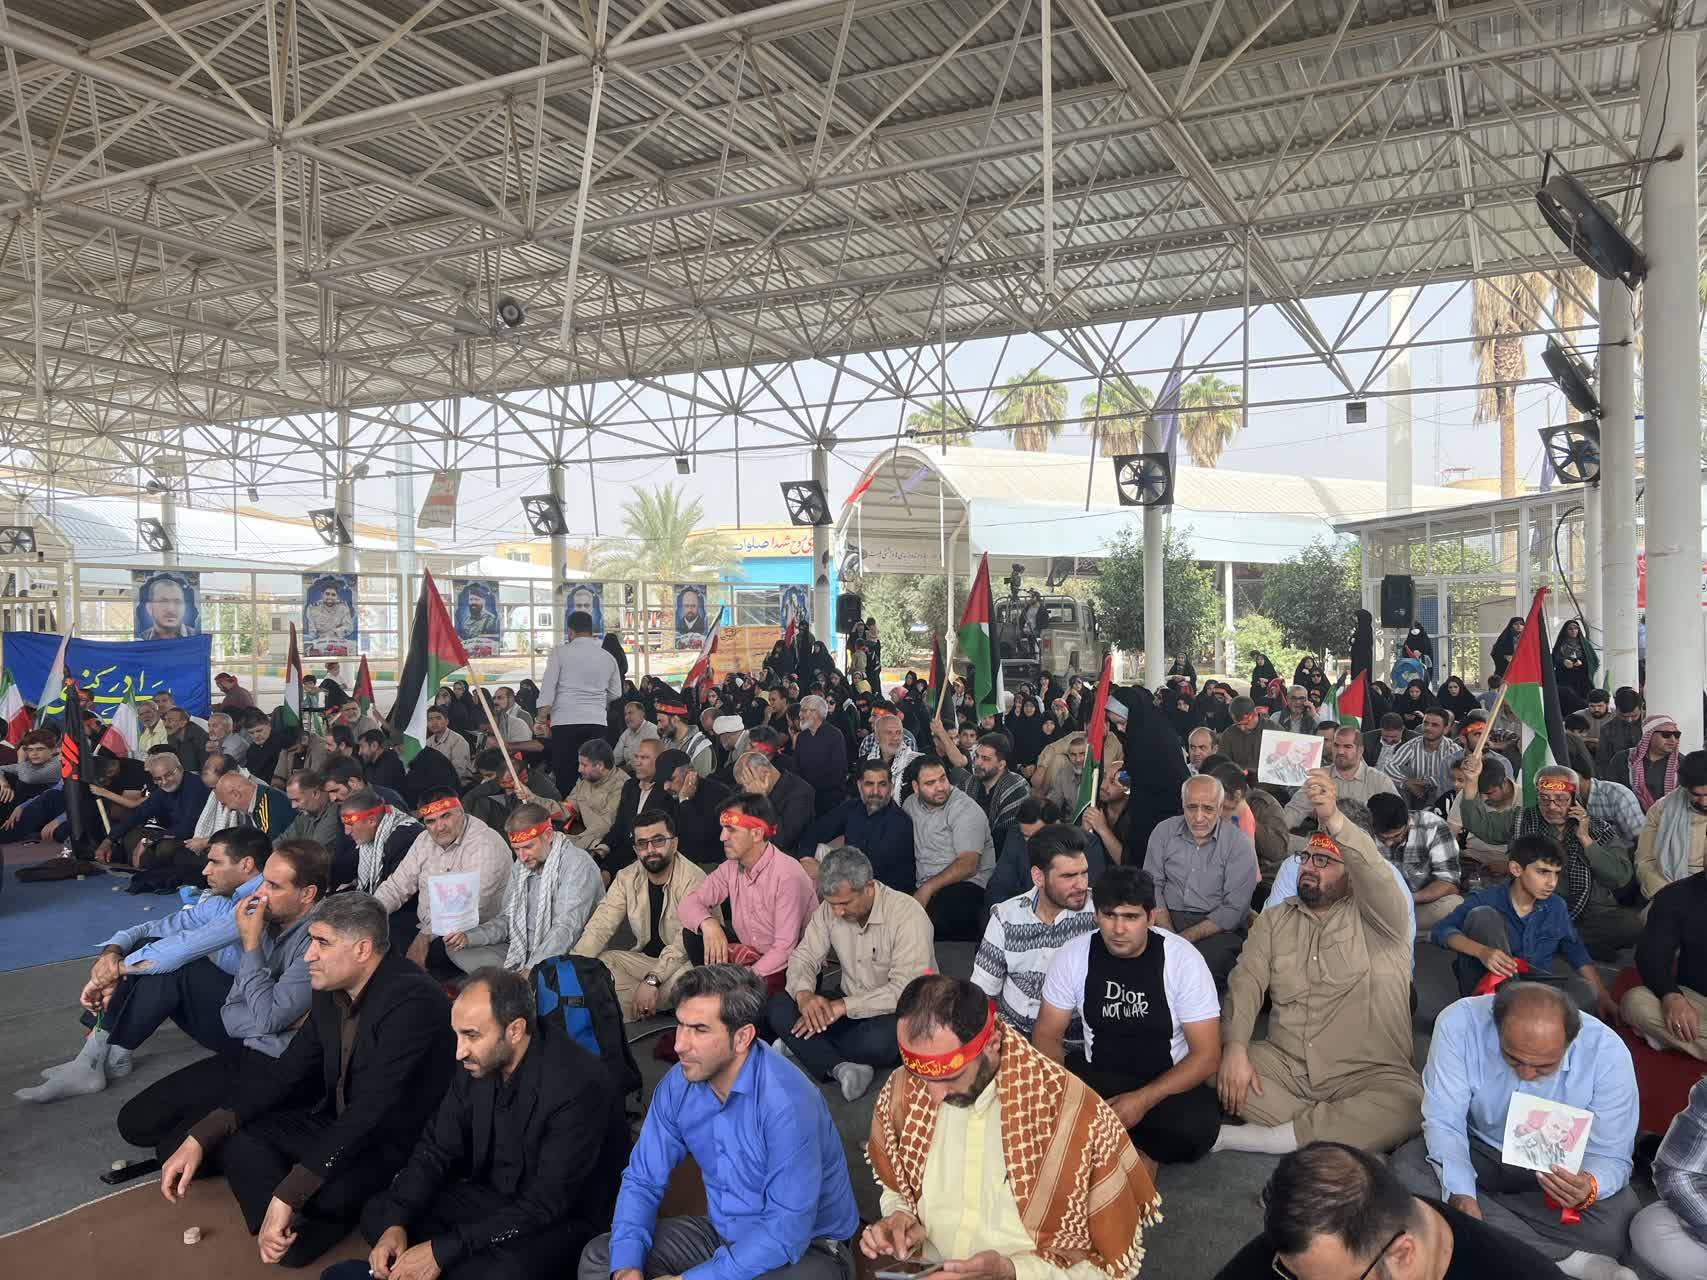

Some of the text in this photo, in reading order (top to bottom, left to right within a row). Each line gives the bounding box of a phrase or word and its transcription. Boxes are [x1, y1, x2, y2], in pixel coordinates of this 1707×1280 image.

[771, 535, 790, 550] شهدا
[1104, 980, 1145, 1004] Dior
[1102, 1001, 1149, 1020] NOT WAR
